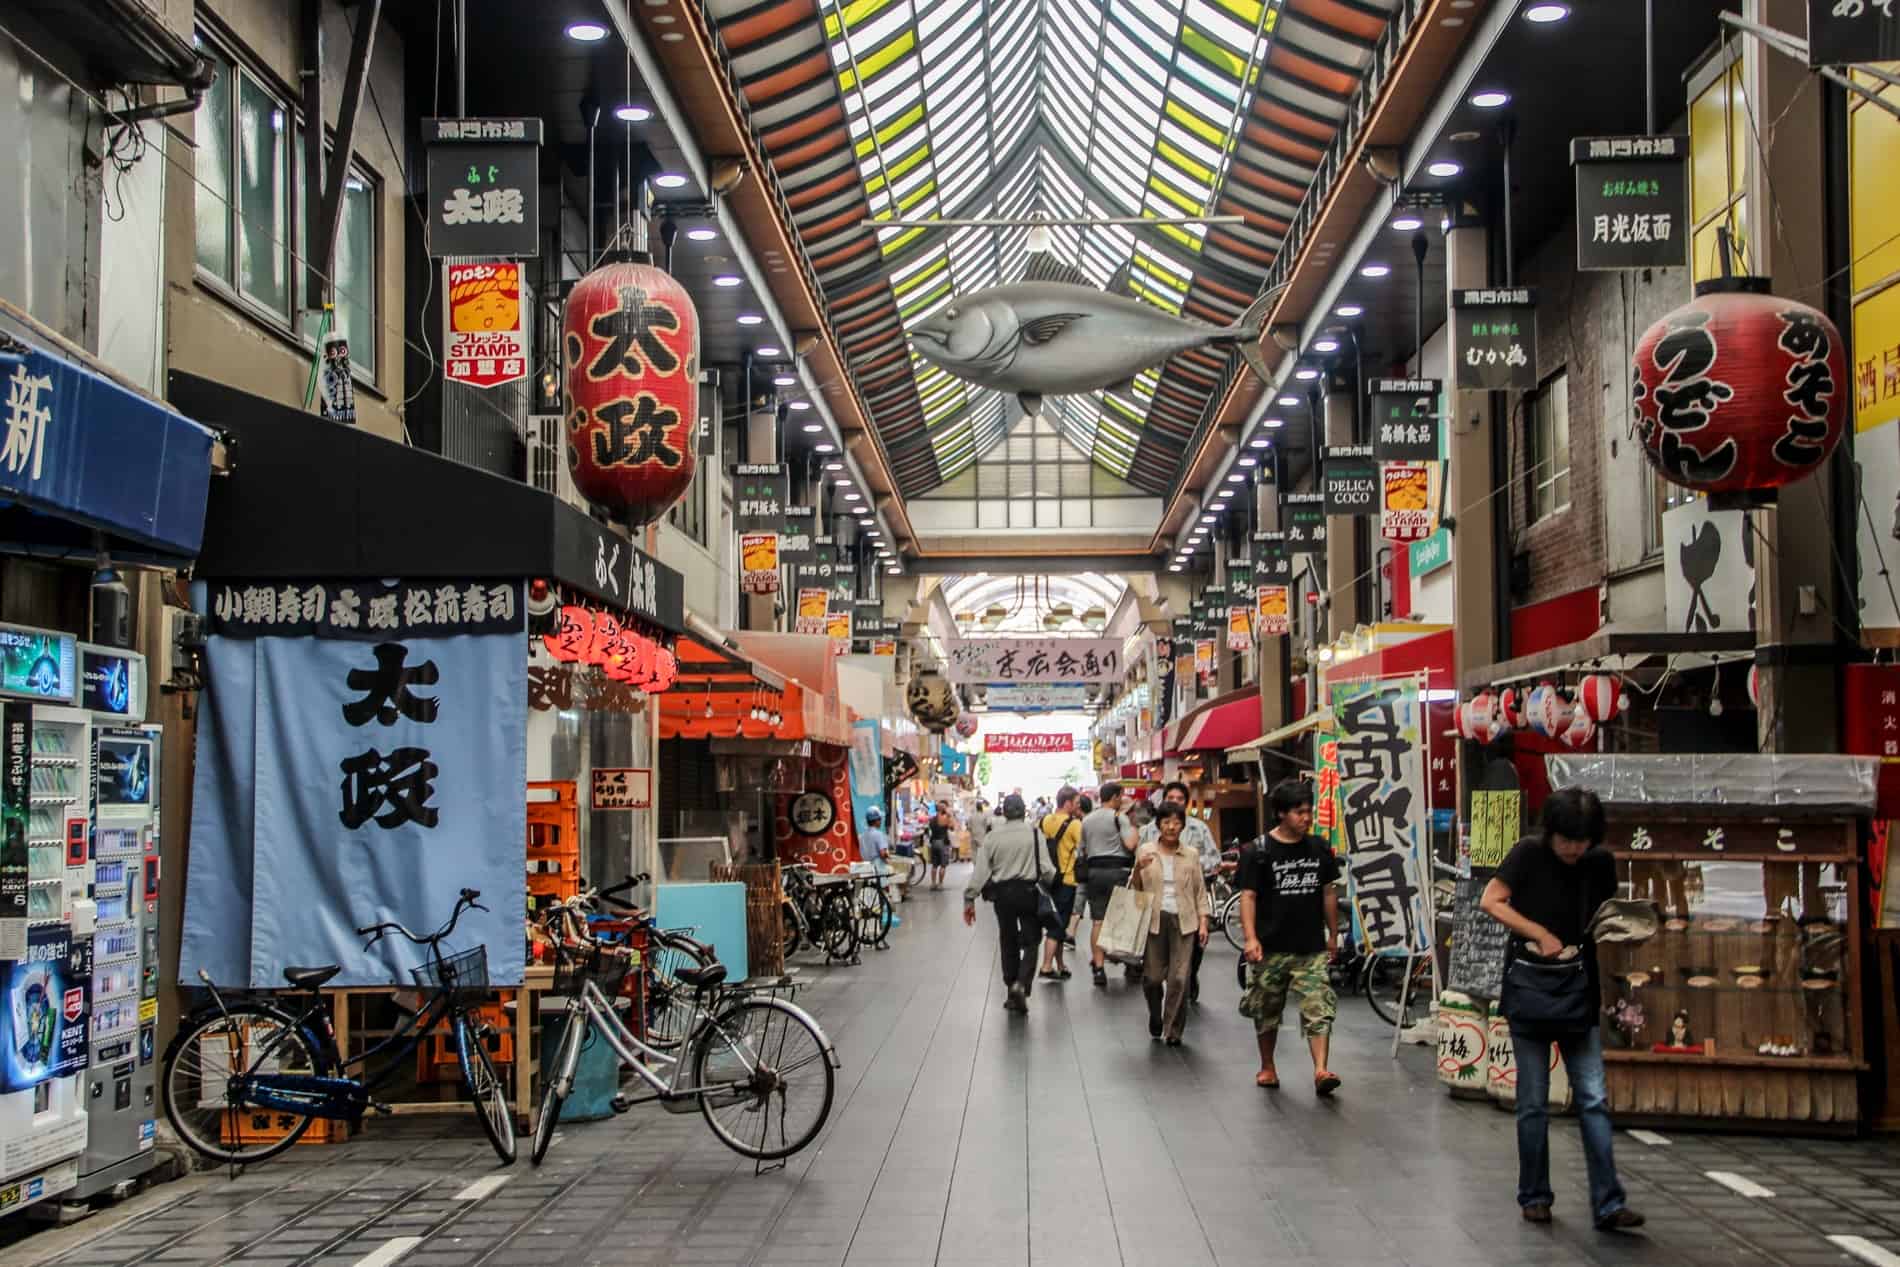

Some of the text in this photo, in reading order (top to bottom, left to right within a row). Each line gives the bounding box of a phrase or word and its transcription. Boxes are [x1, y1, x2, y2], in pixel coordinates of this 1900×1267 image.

[438, 121, 524, 138] 黒門市場
[1589, 138, 1675, 157] 黒門市場
[1592, 213, 1671, 243] 月光仮面
[451, 265, 495, 285] クロモン
[456, 333, 512, 344] フレッシュ
[451, 344, 520, 358] STAMP
[451, 361, 520, 376] 加盟店
[587, 286, 682, 470] 太政
[1653, 311, 1738, 483] うどん
[1, 363, 53, 481] 新
[1328, 480, 1375, 492] DELICA
[1334, 493, 1369, 504] COCO
[595, 535, 619, 597] ふぐ
[215, 585, 327, 624] 小鯛寿司
[404, 583, 515, 627] 松前寿司
[1881, 689, 1898, 754] 消火器
[340, 642, 440, 830] 太政
[1630, 827, 1798, 851] あそこ
[61, 1024, 84, 1040] KENT
